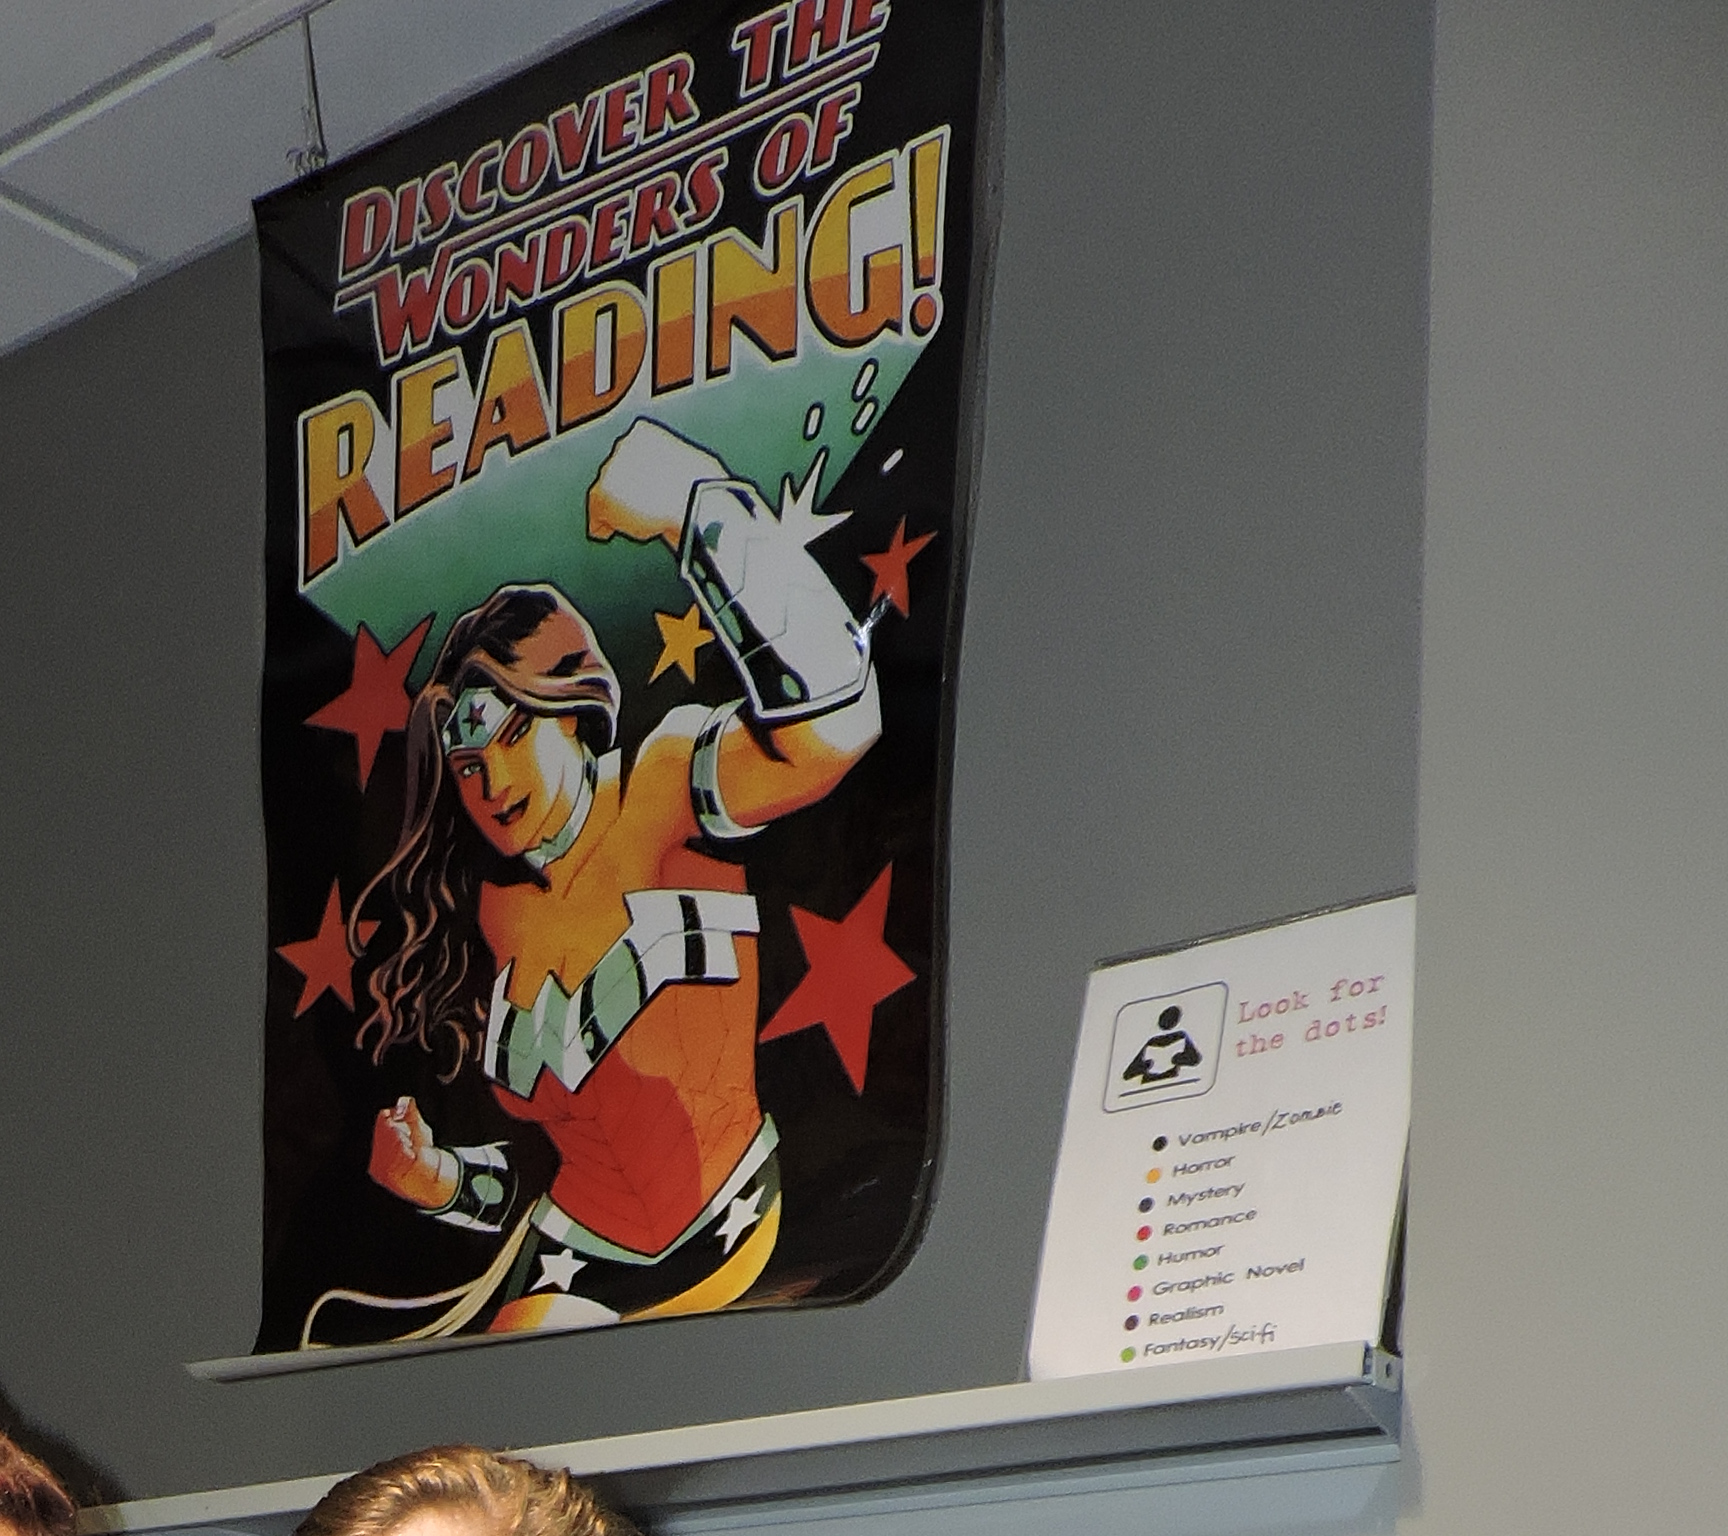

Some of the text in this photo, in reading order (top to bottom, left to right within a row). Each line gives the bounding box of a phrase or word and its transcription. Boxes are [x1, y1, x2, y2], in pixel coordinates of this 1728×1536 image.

[338, 53, 699, 281] DISCOVER
[372, 81, 861, 366] WONDERS OF
[299, 125, 951, 592] READING!
[1237, 974, 1385, 1024] Look for
[1235, 1005, 1388, 1057] the dots!
[1172, 1155, 1236, 1178] Horror
[1166, 1182, 1246, 1207] Mystery
[1162, 1209, 1258, 1236] Romance
[1157, 1244, 1225, 1267] Humor
[1152, 1257, 1306, 1296] Graphic Novel
[1147, 1303, 1224, 1327] Realism
